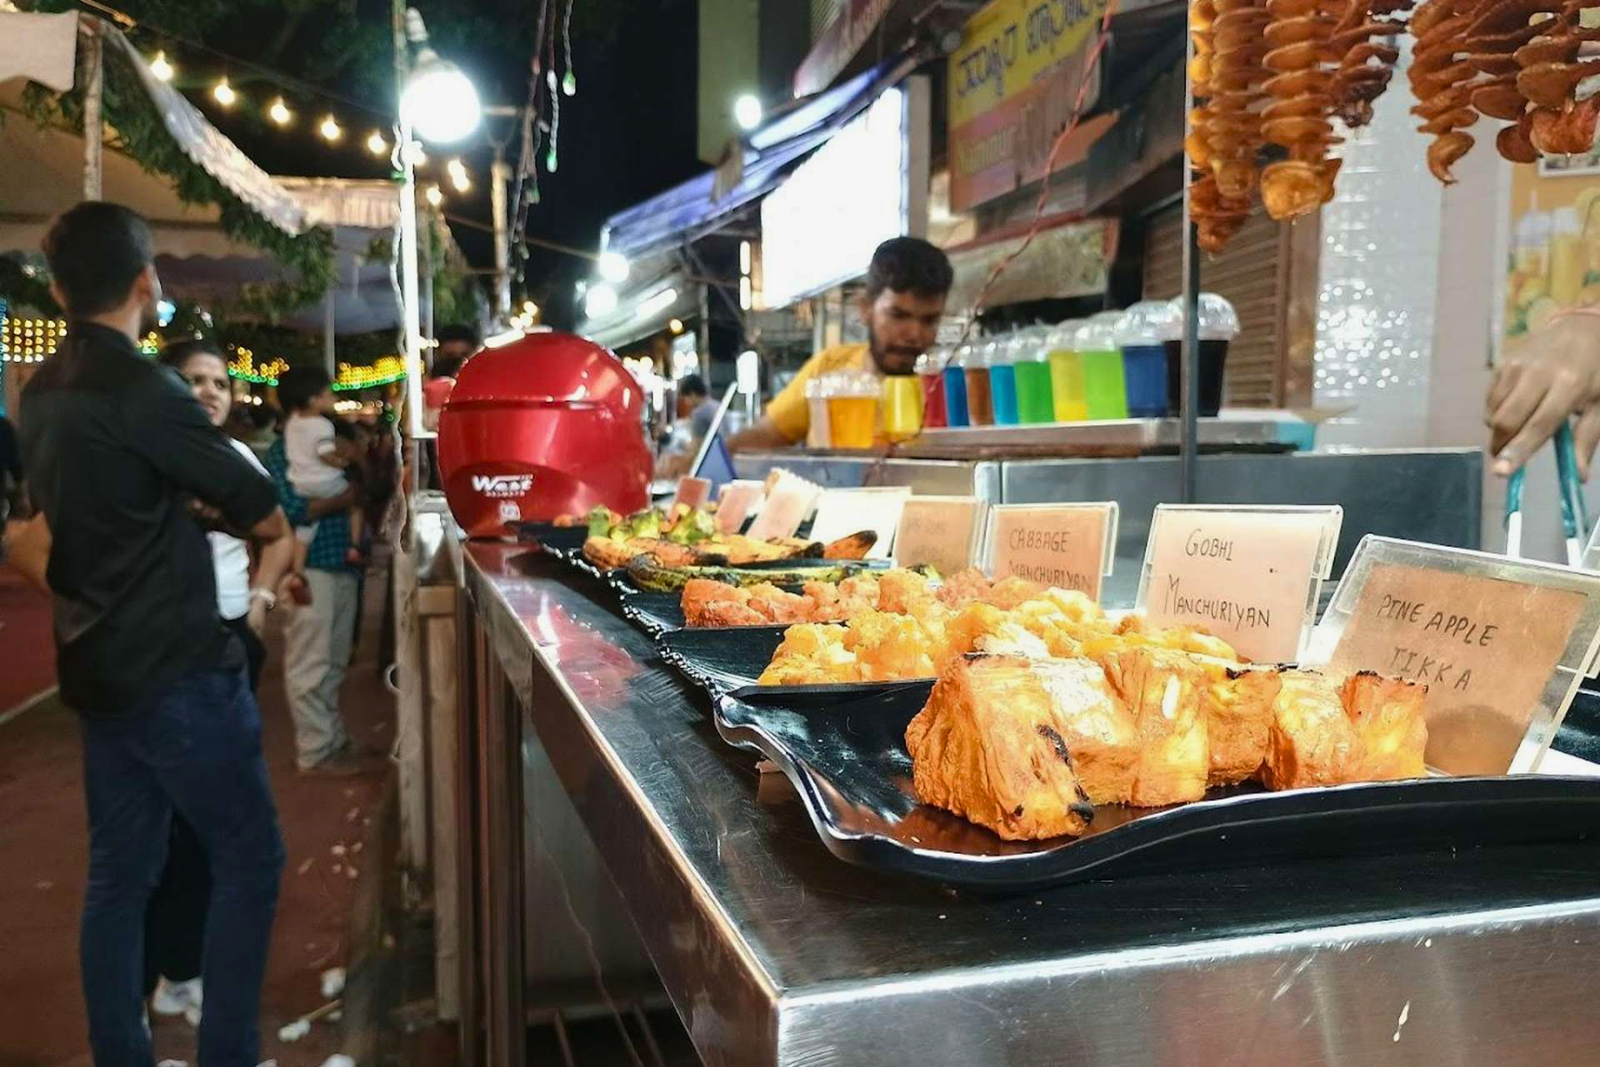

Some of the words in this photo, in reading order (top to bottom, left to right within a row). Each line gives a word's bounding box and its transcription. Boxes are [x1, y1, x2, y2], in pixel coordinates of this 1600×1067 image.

[1009, 528, 1070, 553] CABBAGE
[1185, 528, 1234, 561] GOBHI
[1163, 573, 1271, 632] MANCHURIYAN
[1389, 646, 1472, 691] TIKKA
